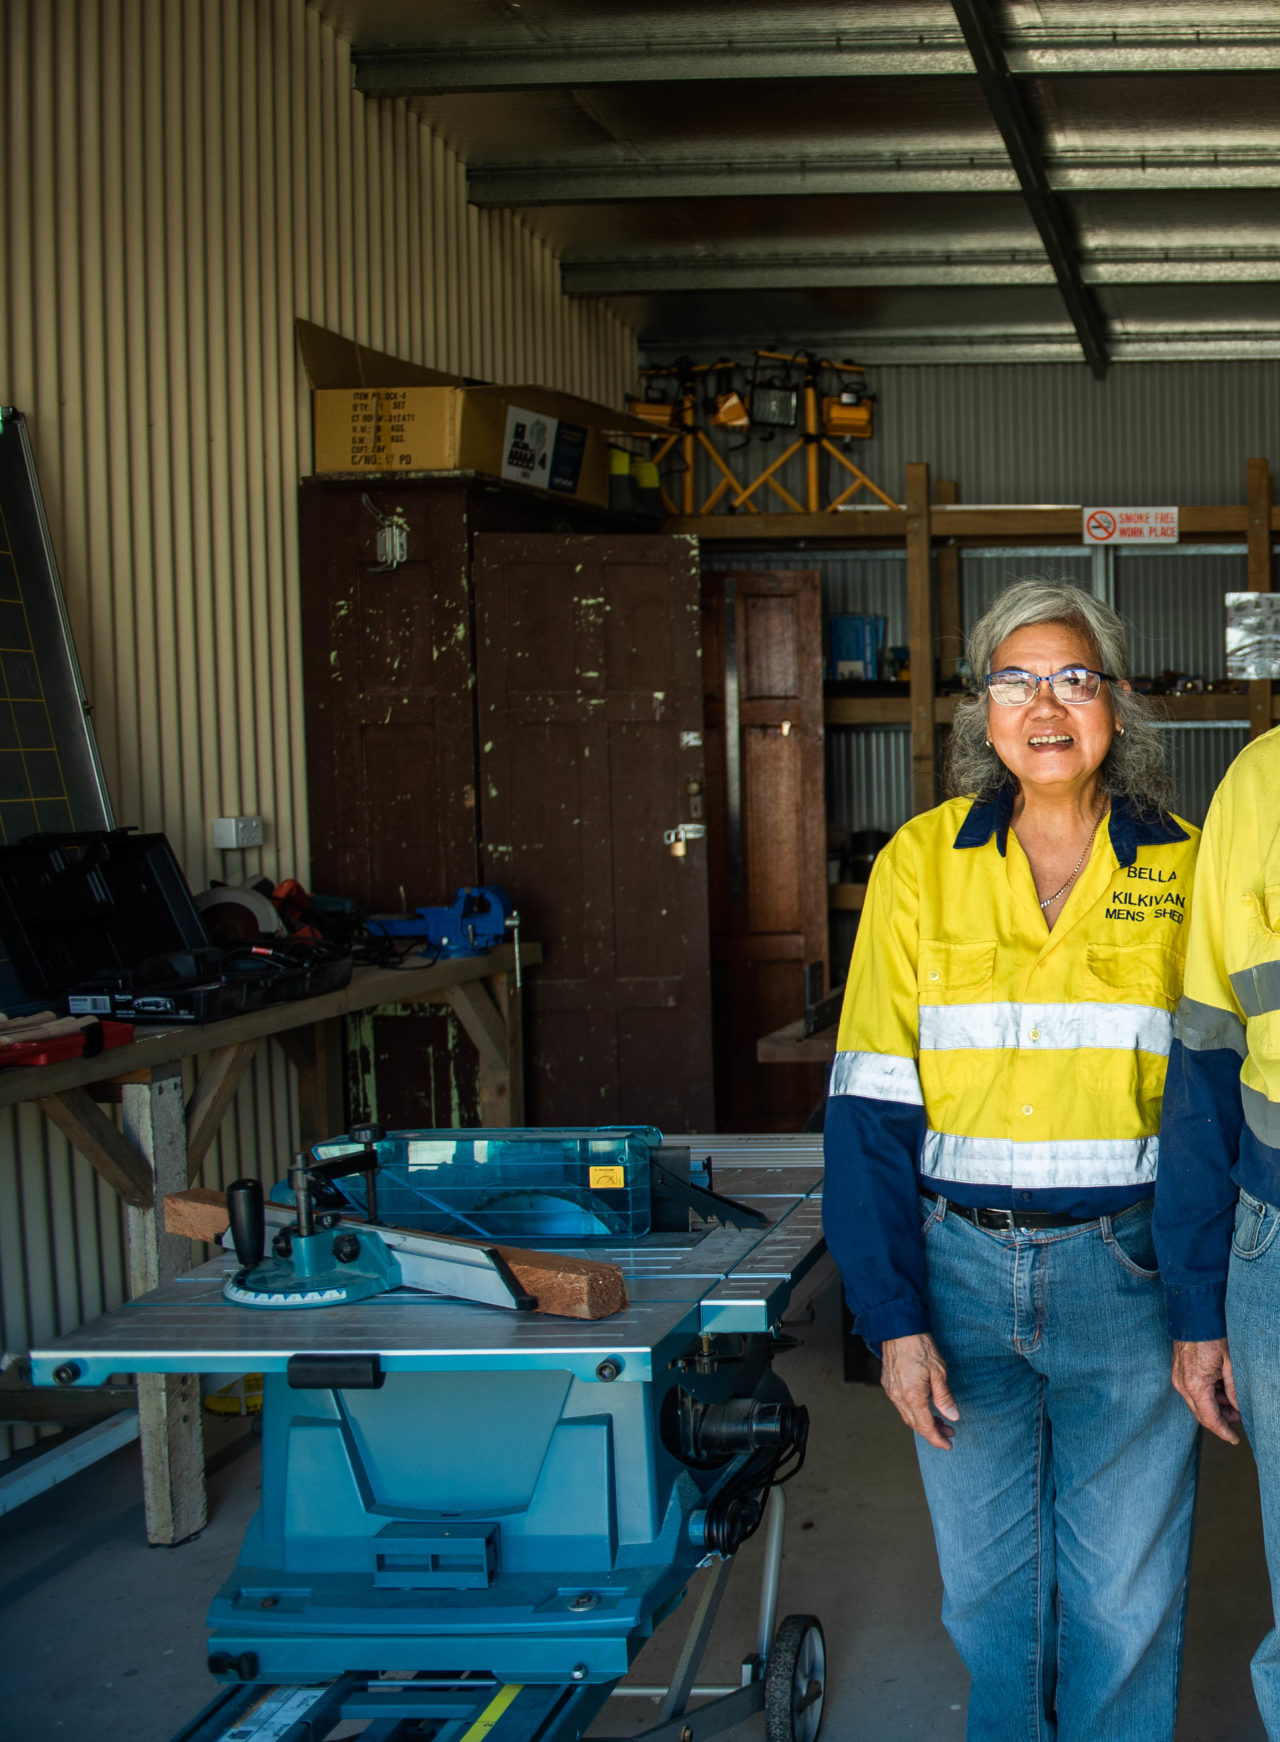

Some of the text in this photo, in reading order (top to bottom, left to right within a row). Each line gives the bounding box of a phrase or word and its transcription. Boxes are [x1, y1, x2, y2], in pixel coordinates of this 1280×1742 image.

[1119, 511, 1177, 524] SMOKE FREE
[1118, 526, 1177, 538] WORK PLACE
[1126, 865, 1177, 884] BELLA
[1111, 890, 1186, 909] KILKIVAN
[1104, 907, 1185, 925] MENS SHED
